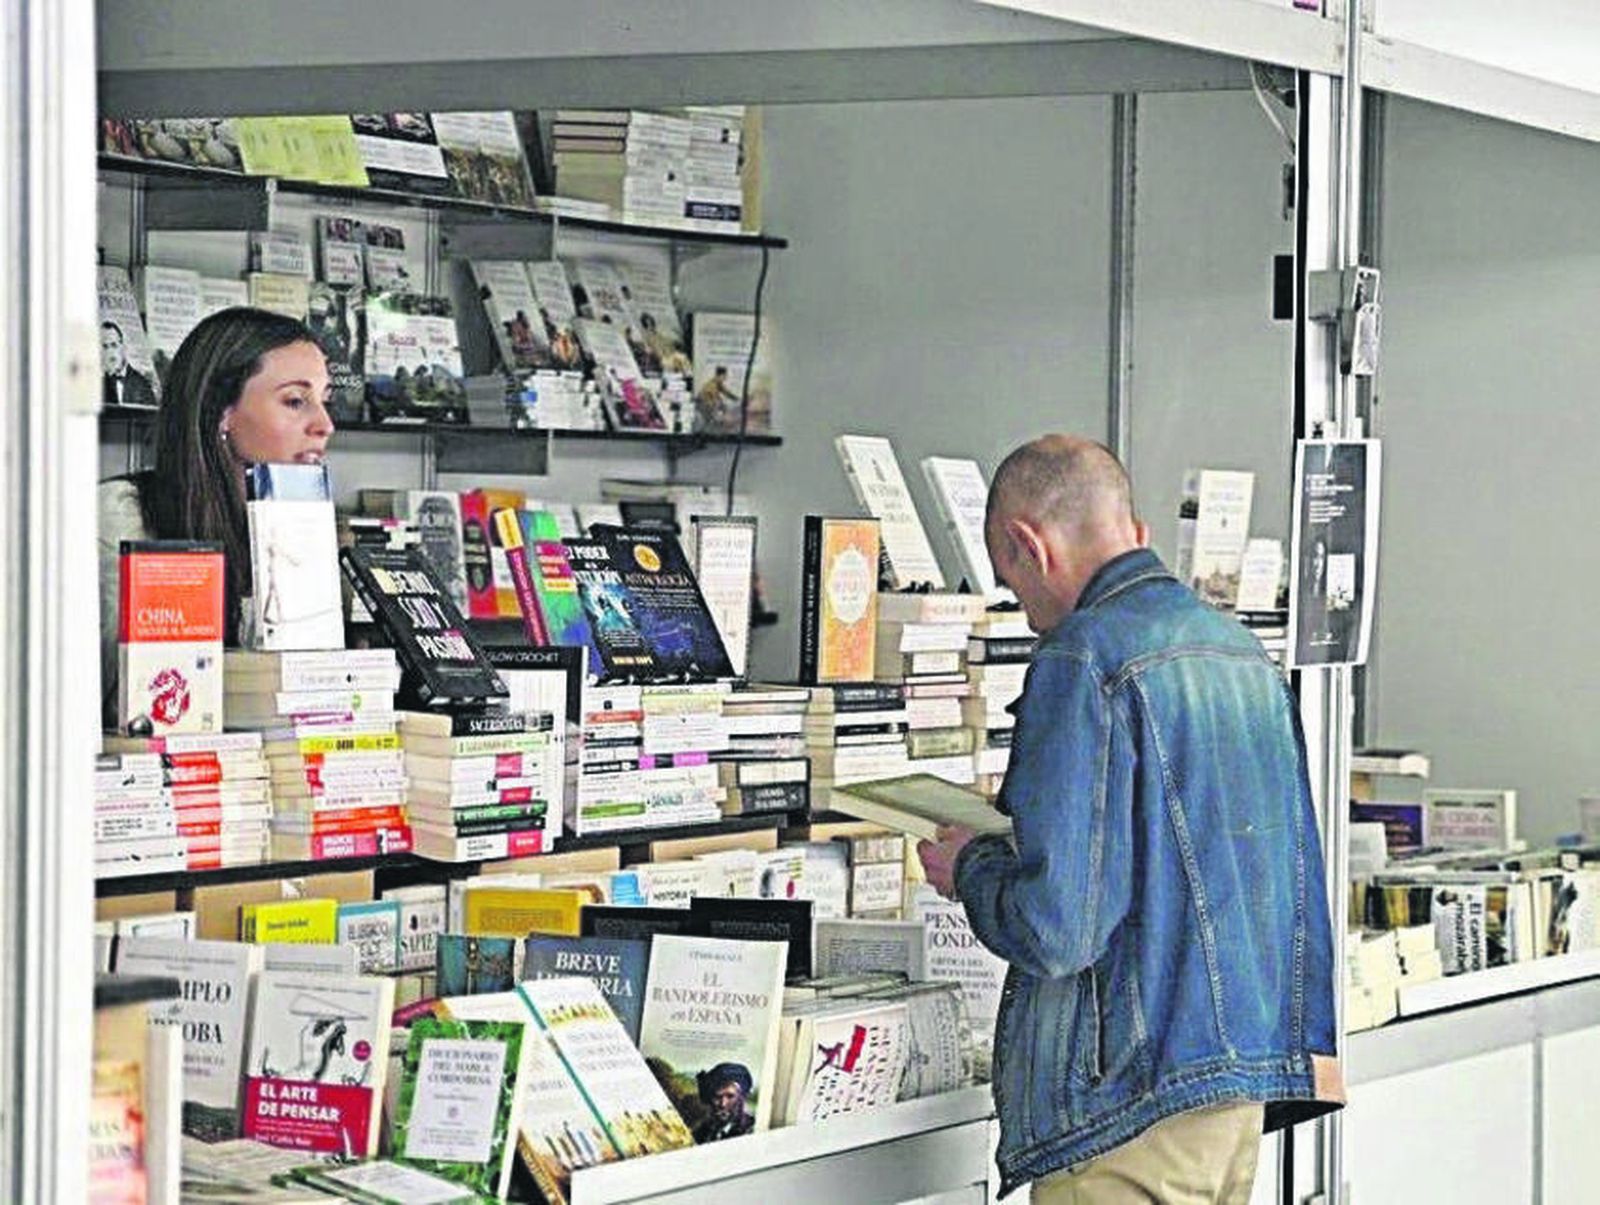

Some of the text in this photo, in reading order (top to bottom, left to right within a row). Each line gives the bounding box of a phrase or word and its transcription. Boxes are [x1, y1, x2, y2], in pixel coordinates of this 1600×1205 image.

[137, 607, 186, 625] CHINA
[416, 632, 475, 661] PASIÓN
[515, 651, 560, 664] CROCHET
[1469, 903, 1483, 971] El camino
[555, 951, 621, 973] BREVE
[703, 971, 723, 989] EL
[652, 986, 769, 1008] BANDOLERISMO
[687, 1007, 742, 1026] ESPAÑA
[428, 1049, 499, 1062] DICCIONARIO
[433, 1061, 491, 1074] DEL HABLA
[427, 1073, 492, 1085] CORDOBESA
[259, 1083, 319, 1102] EL ARTE
[257, 1101, 341, 1122] DE PENSAR
